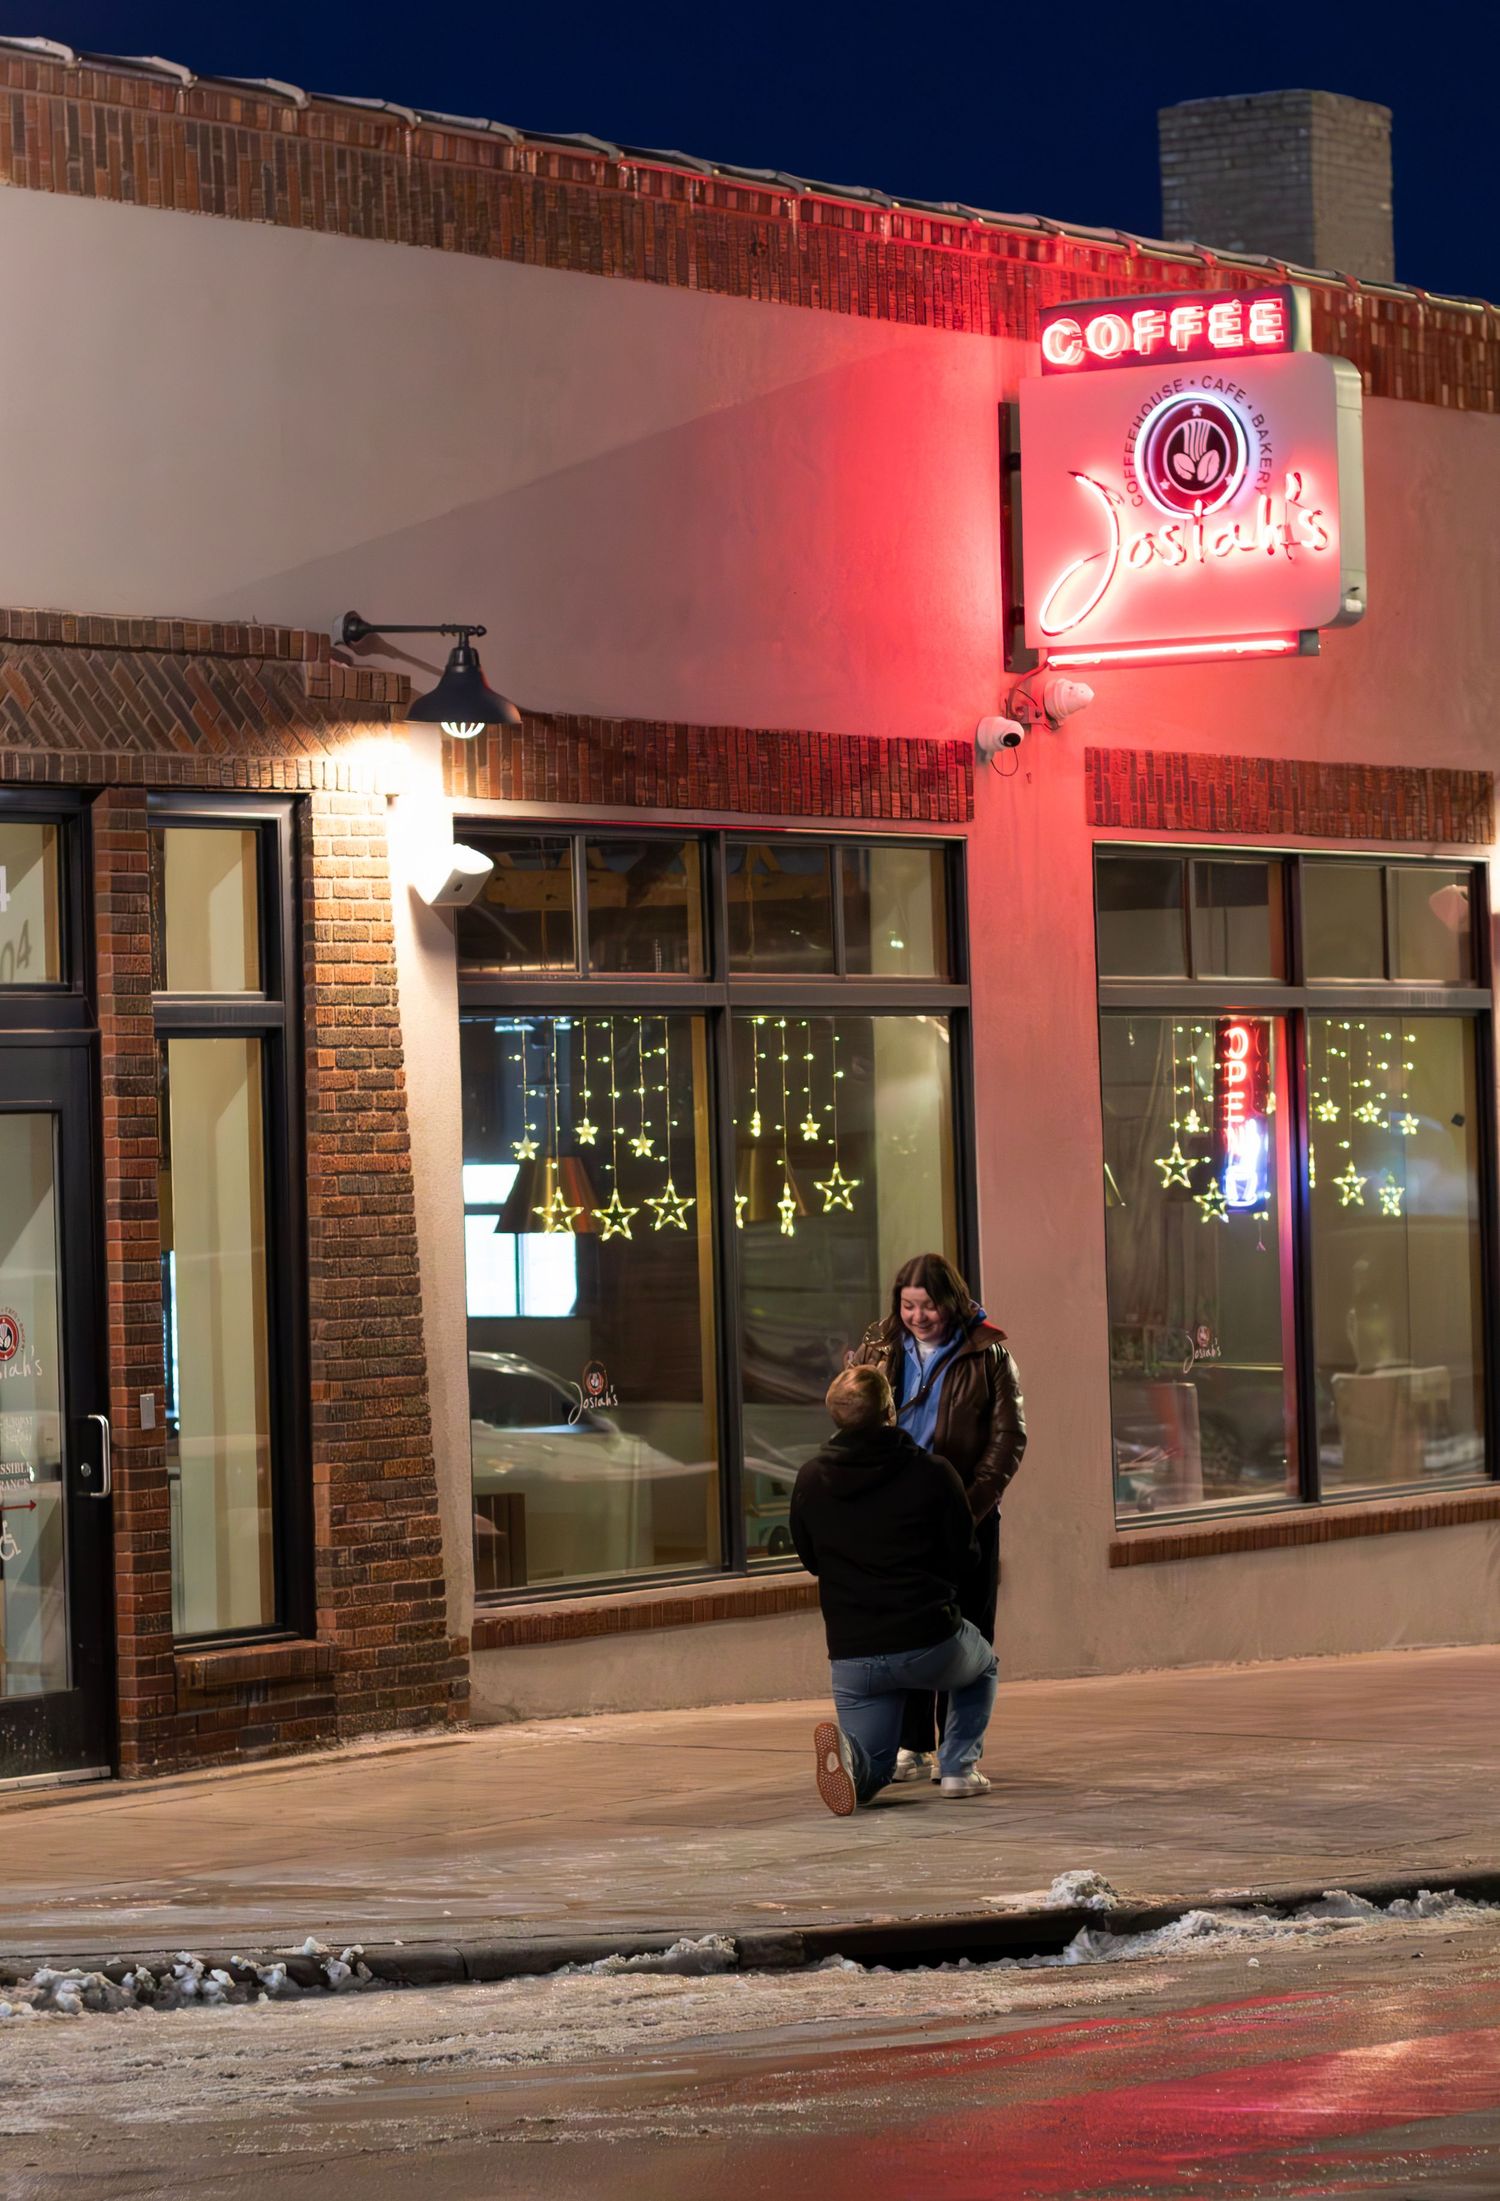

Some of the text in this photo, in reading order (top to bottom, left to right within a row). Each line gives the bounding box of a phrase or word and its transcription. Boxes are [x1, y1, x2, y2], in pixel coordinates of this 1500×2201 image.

[1042, 297, 1284, 366] COFFEE
[1123, 375, 1273, 508] COFFEEHOUSE CAFE BAKERY
[1039, 469, 1329, 635] Josiah's
[1223, 1026, 1250, 1156] OPEN
[0, 1343, 43, 1379] iah's
[1183, 1334, 1222, 1374] Josiah's
[567, 1380, 619, 1426] Josiah's
